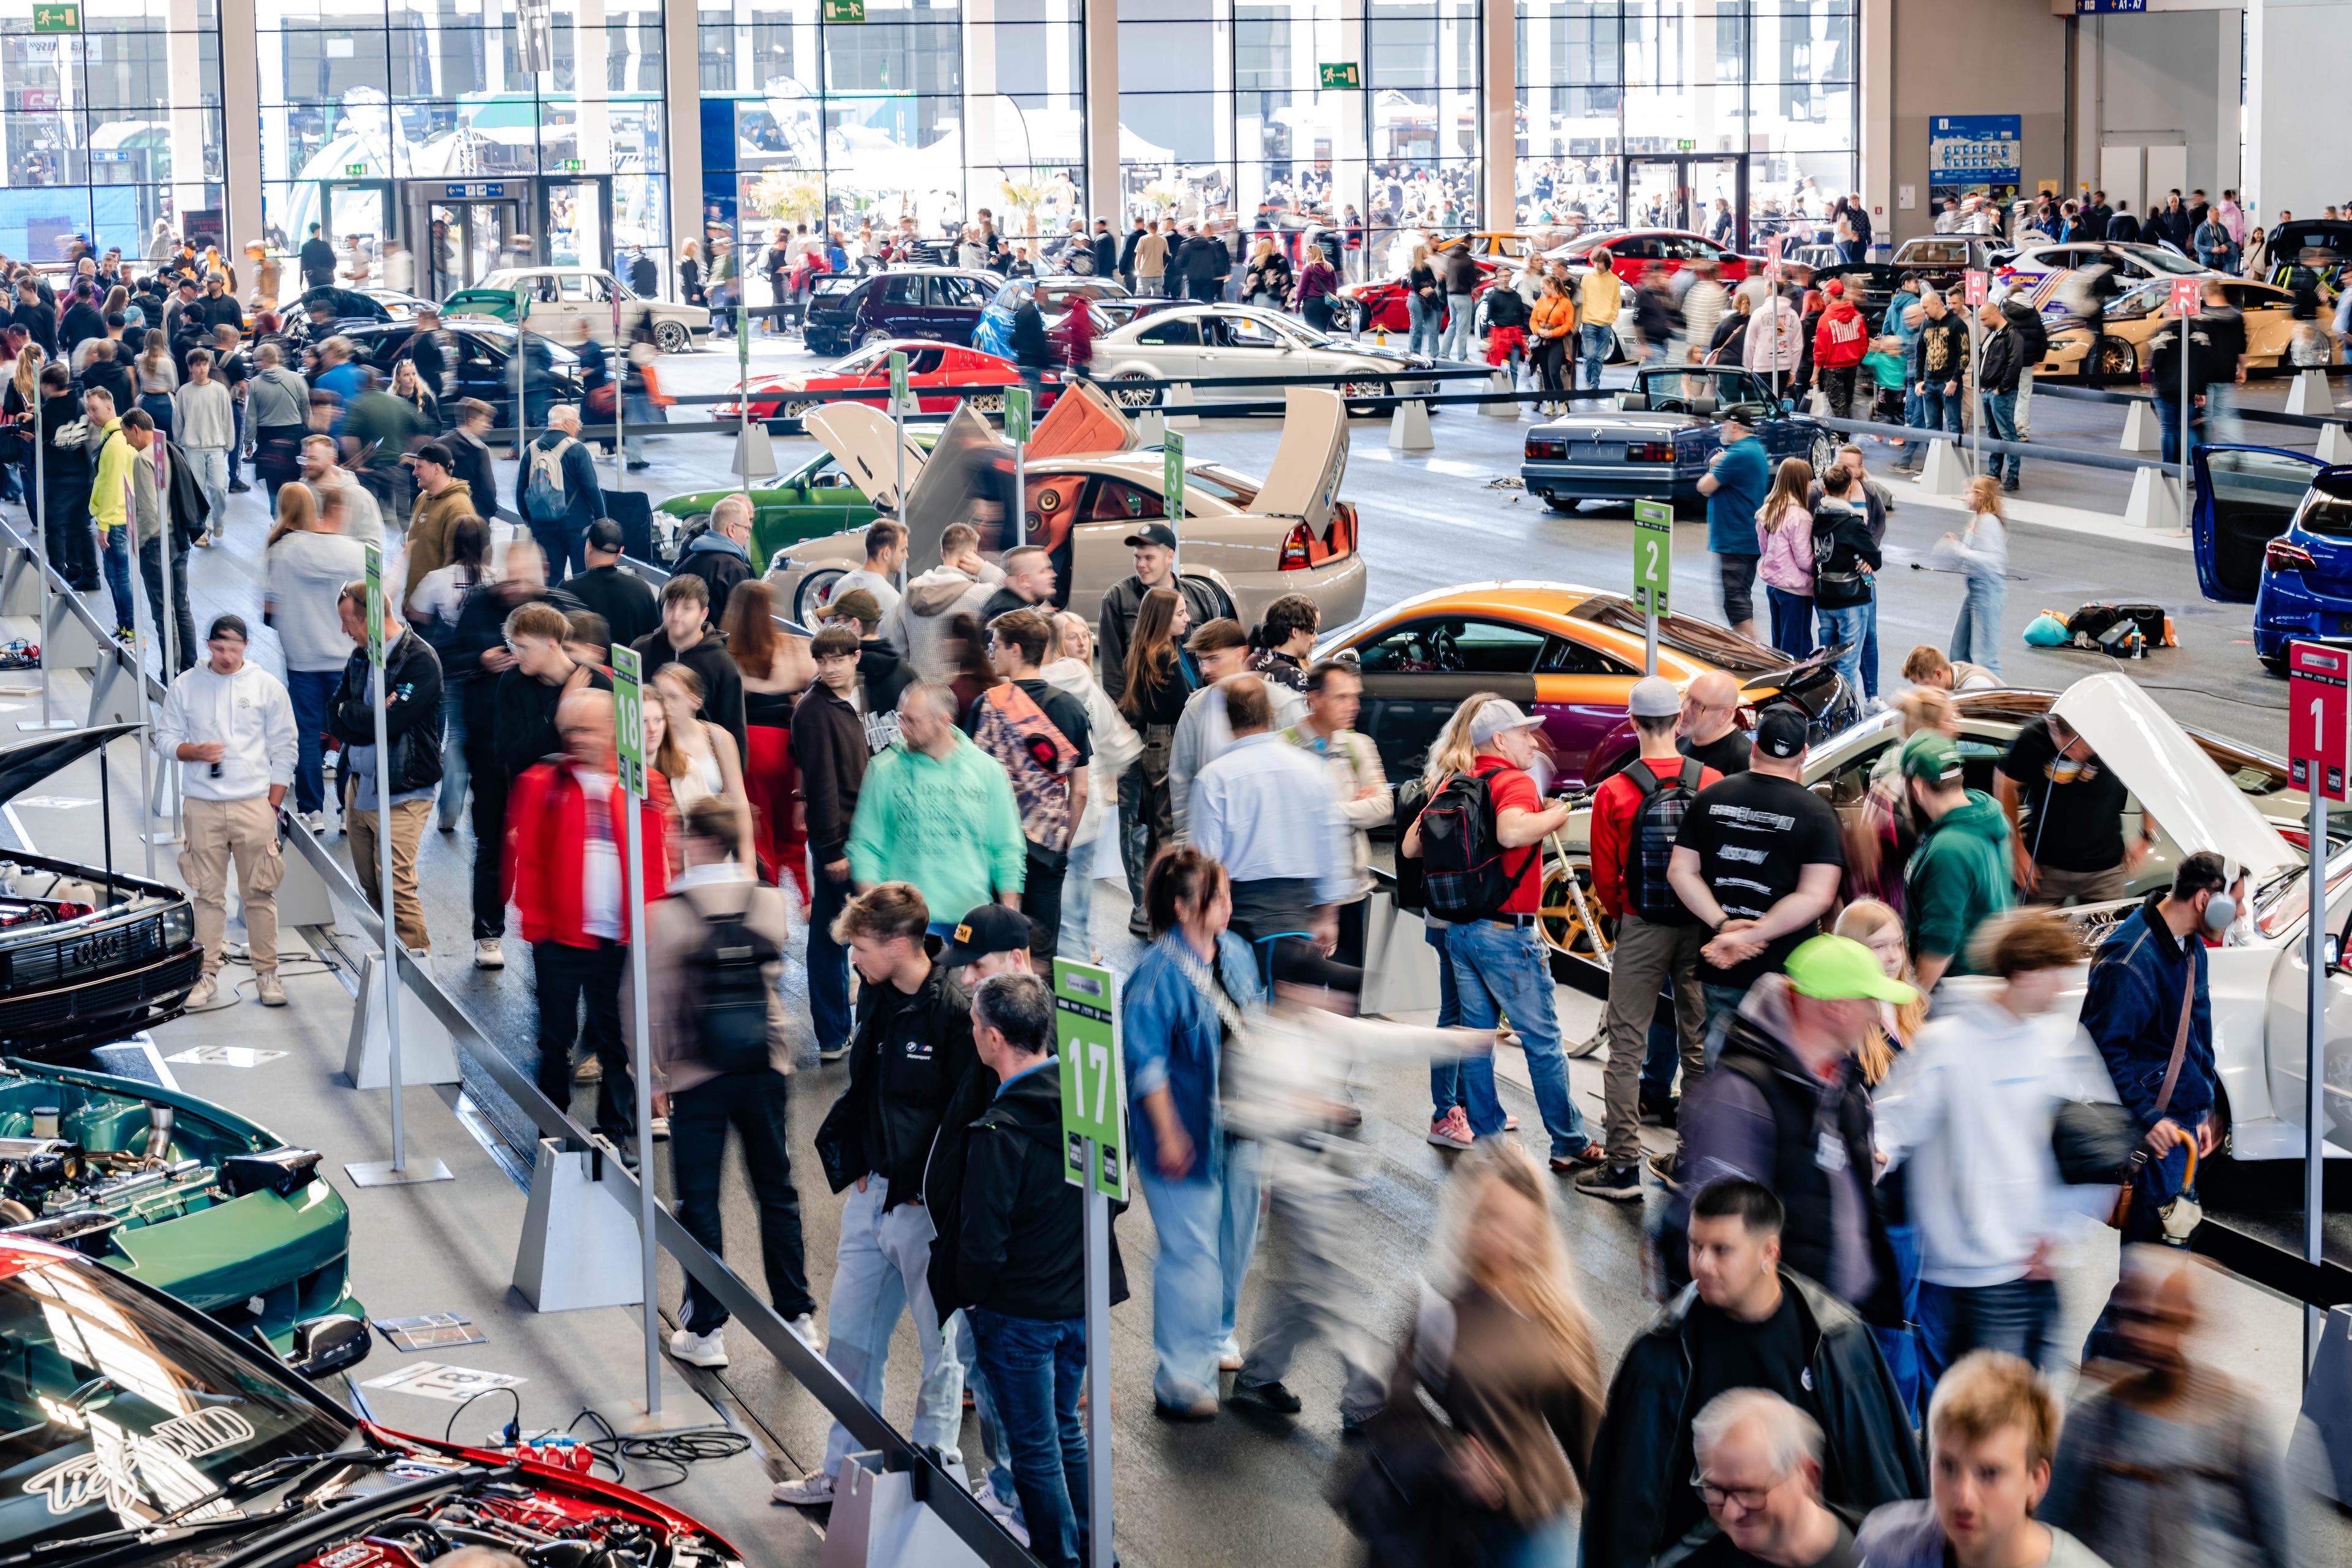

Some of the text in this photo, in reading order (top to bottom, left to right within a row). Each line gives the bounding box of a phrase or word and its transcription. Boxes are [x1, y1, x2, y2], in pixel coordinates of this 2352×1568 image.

[2119, 0, 2127, 9] A1
[2133, 0, 2143, 9] A7
[1769, 252, 1779, 270] 16
[2179, 284, 2191, 310] 14
[1012, 405, 1022, 426] 4
[1170, 460, 1177, 492] 3
[1646, 540, 1659, 582] 2
[369, 586, 379, 631] 19
[619, 693, 638, 751] 18
[2310, 697, 2323, 752] 1
[2293, 771, 2306, 780] WORLD
[2328, 778, 2342, 788] WORLD
[1068, 1037, 1108, 1125] 17
